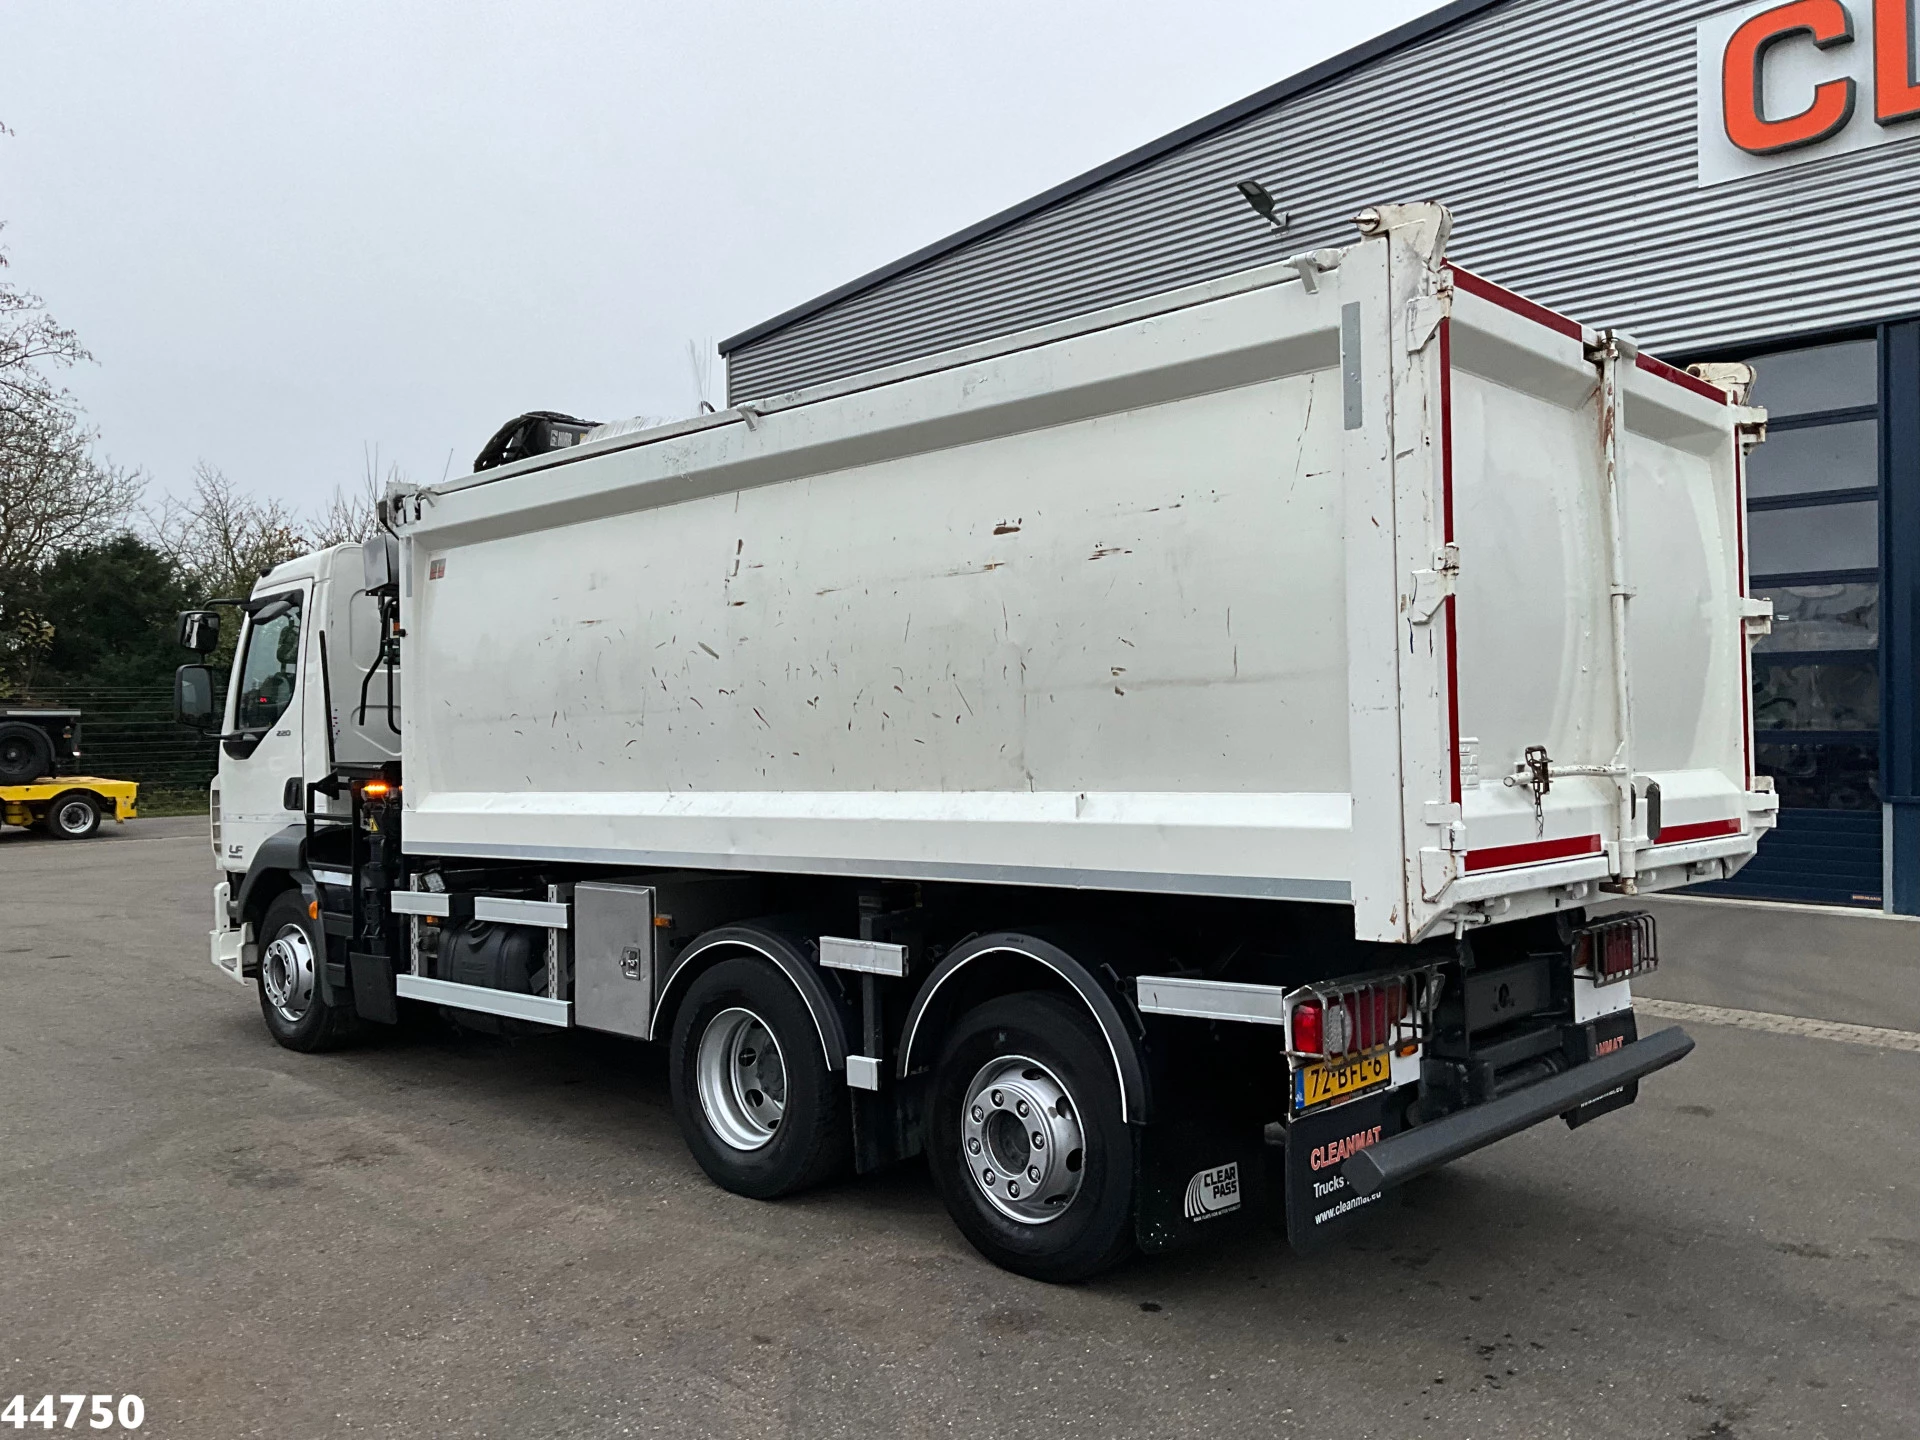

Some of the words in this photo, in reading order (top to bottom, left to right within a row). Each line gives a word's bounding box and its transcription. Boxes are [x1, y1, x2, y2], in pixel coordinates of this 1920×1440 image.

[1310, 1125, 1382, 1171] CLEANMAT
[1203, 1165, 1236, 1188] CLEAR
[1313, 1175, 1345, 1198] Trucks
[1212, 1180, 1237, 1199] PASS
